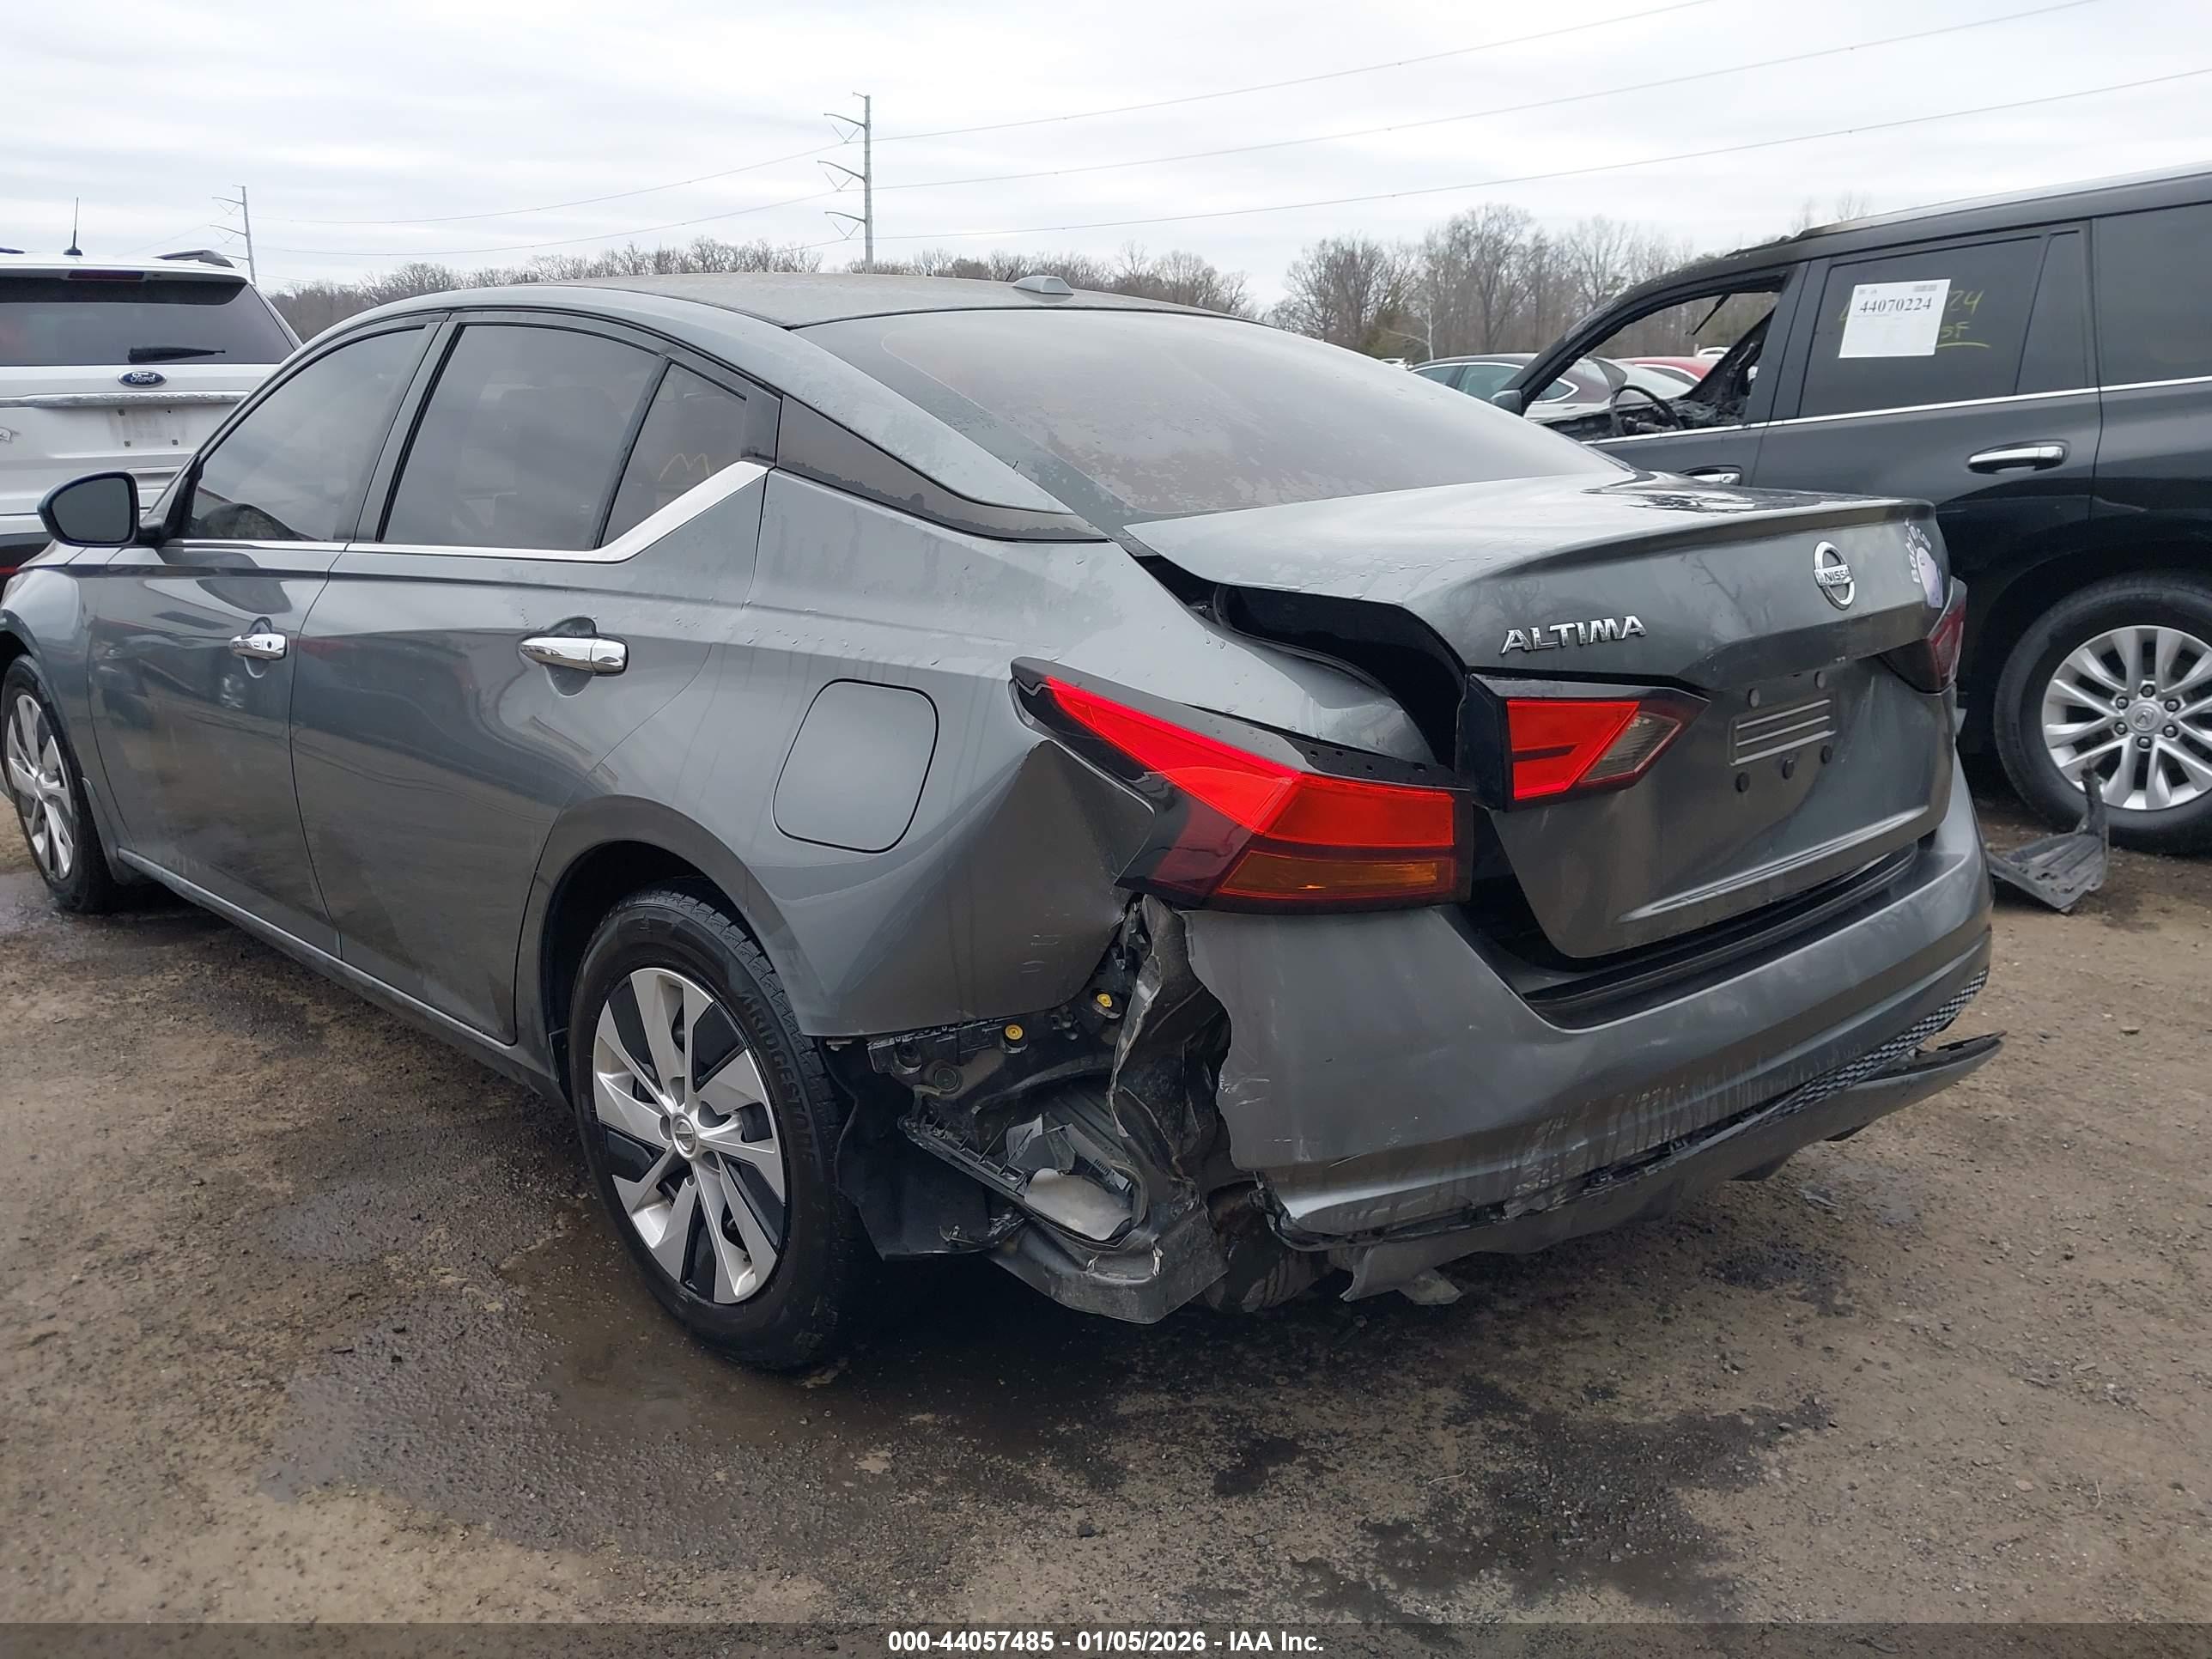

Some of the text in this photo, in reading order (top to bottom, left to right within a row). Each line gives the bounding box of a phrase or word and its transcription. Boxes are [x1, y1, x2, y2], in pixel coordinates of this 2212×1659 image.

[1860, 297, 1932, 313] 44070224
[131, 372, 156, 383] Ford
[1823, 569, 1850, 582] NISSA
[1499, 615, 1648, 655] ALTIMA
